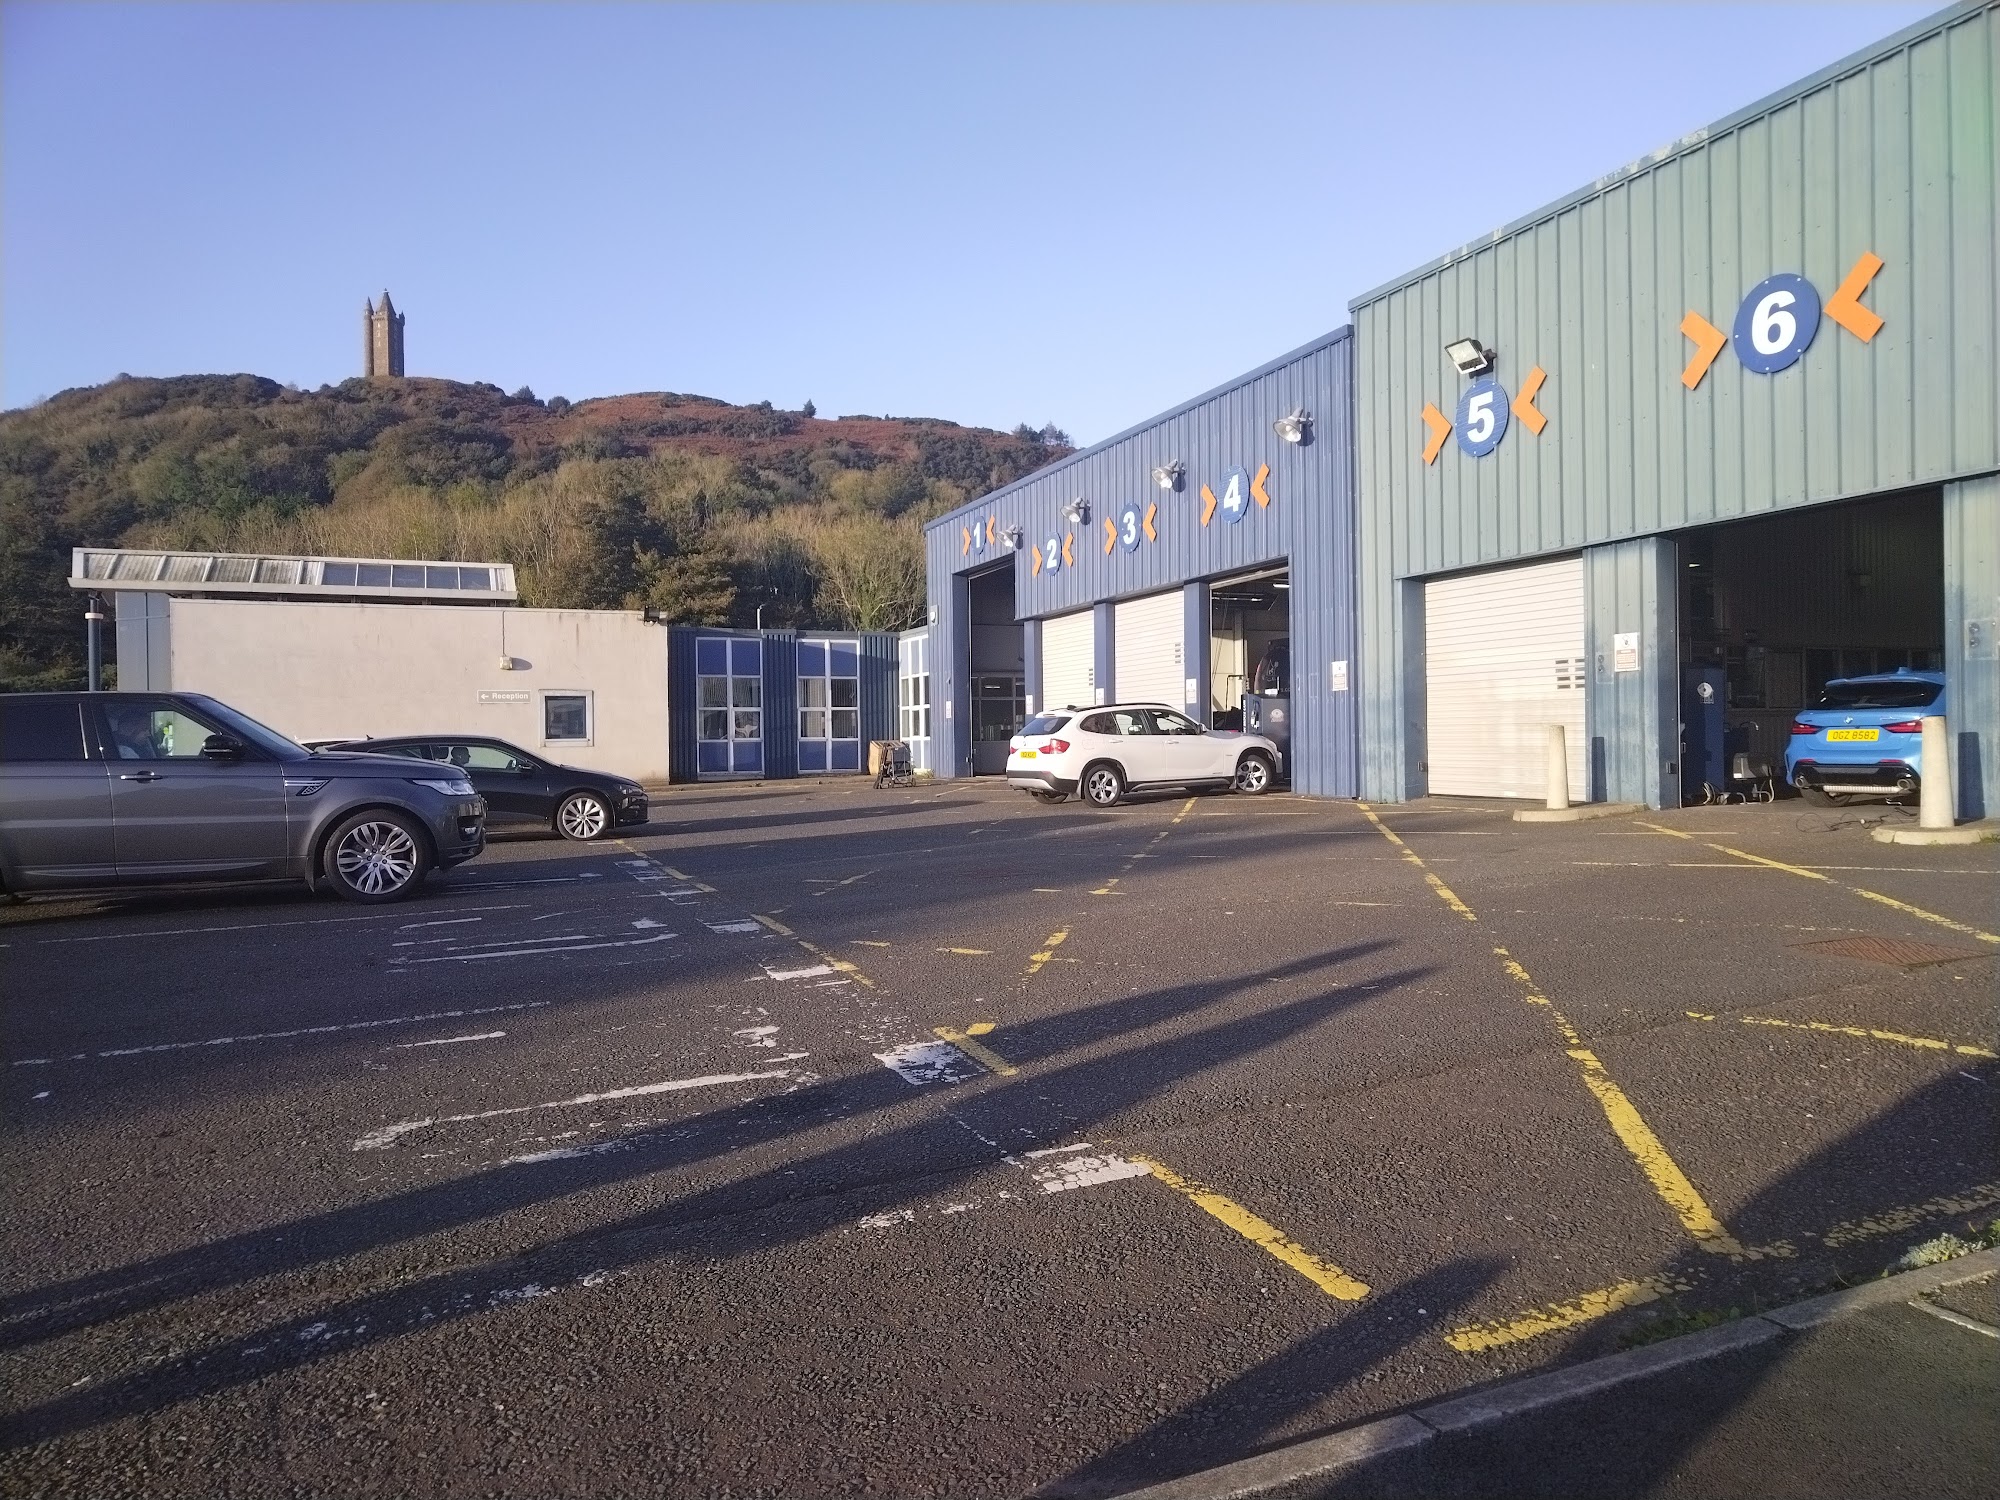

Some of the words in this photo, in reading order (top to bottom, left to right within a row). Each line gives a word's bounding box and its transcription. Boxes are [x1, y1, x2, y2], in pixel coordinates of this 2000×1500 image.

[1751, 290, 1797, 355] 6
[1466, 391, 1495, 443] 5
[1223, 474, 1242, 512] 4
[973, 522, 981, 548] 1
[1123, 511, 1136, 545] 3
[1046, 538, 1057, 569] 2
[491, 692, 529, 701] Reception
[1832, 731, 1850, 740] OGZ
[1852, 731, 1876, 740] 8582
